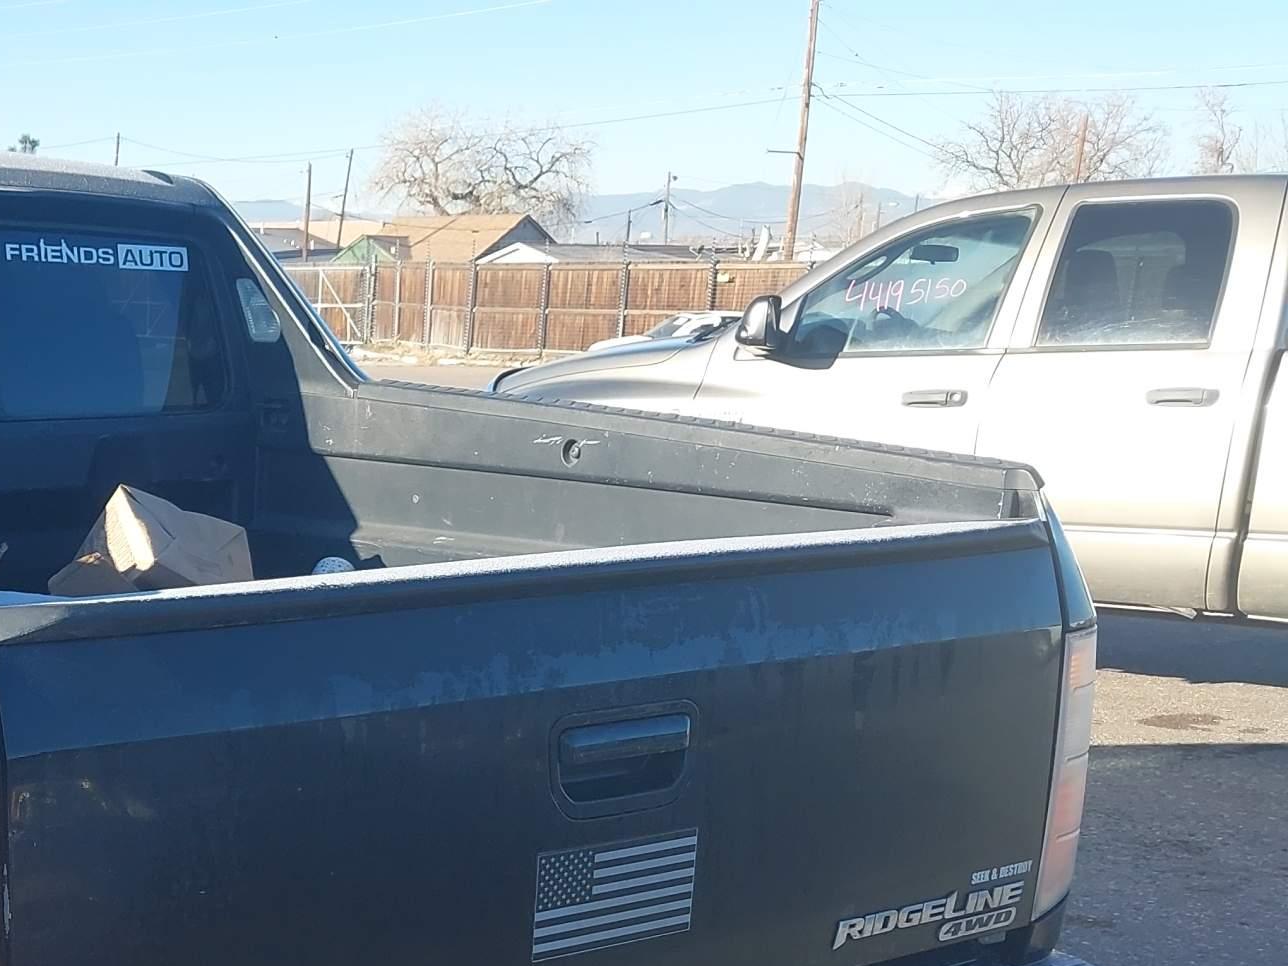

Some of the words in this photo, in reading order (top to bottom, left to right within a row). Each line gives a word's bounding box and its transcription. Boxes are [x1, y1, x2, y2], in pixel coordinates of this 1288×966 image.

[5, 238, 115, 265] FRIENDS
[120, 247, 185, 269] AUTO
[970, 869, 991, 885] SEEK
[991, 867, 998, 881] &
[832, 880, 1025, 951] RIDGELINE
[941, 909, 1015, 941] 4WD
